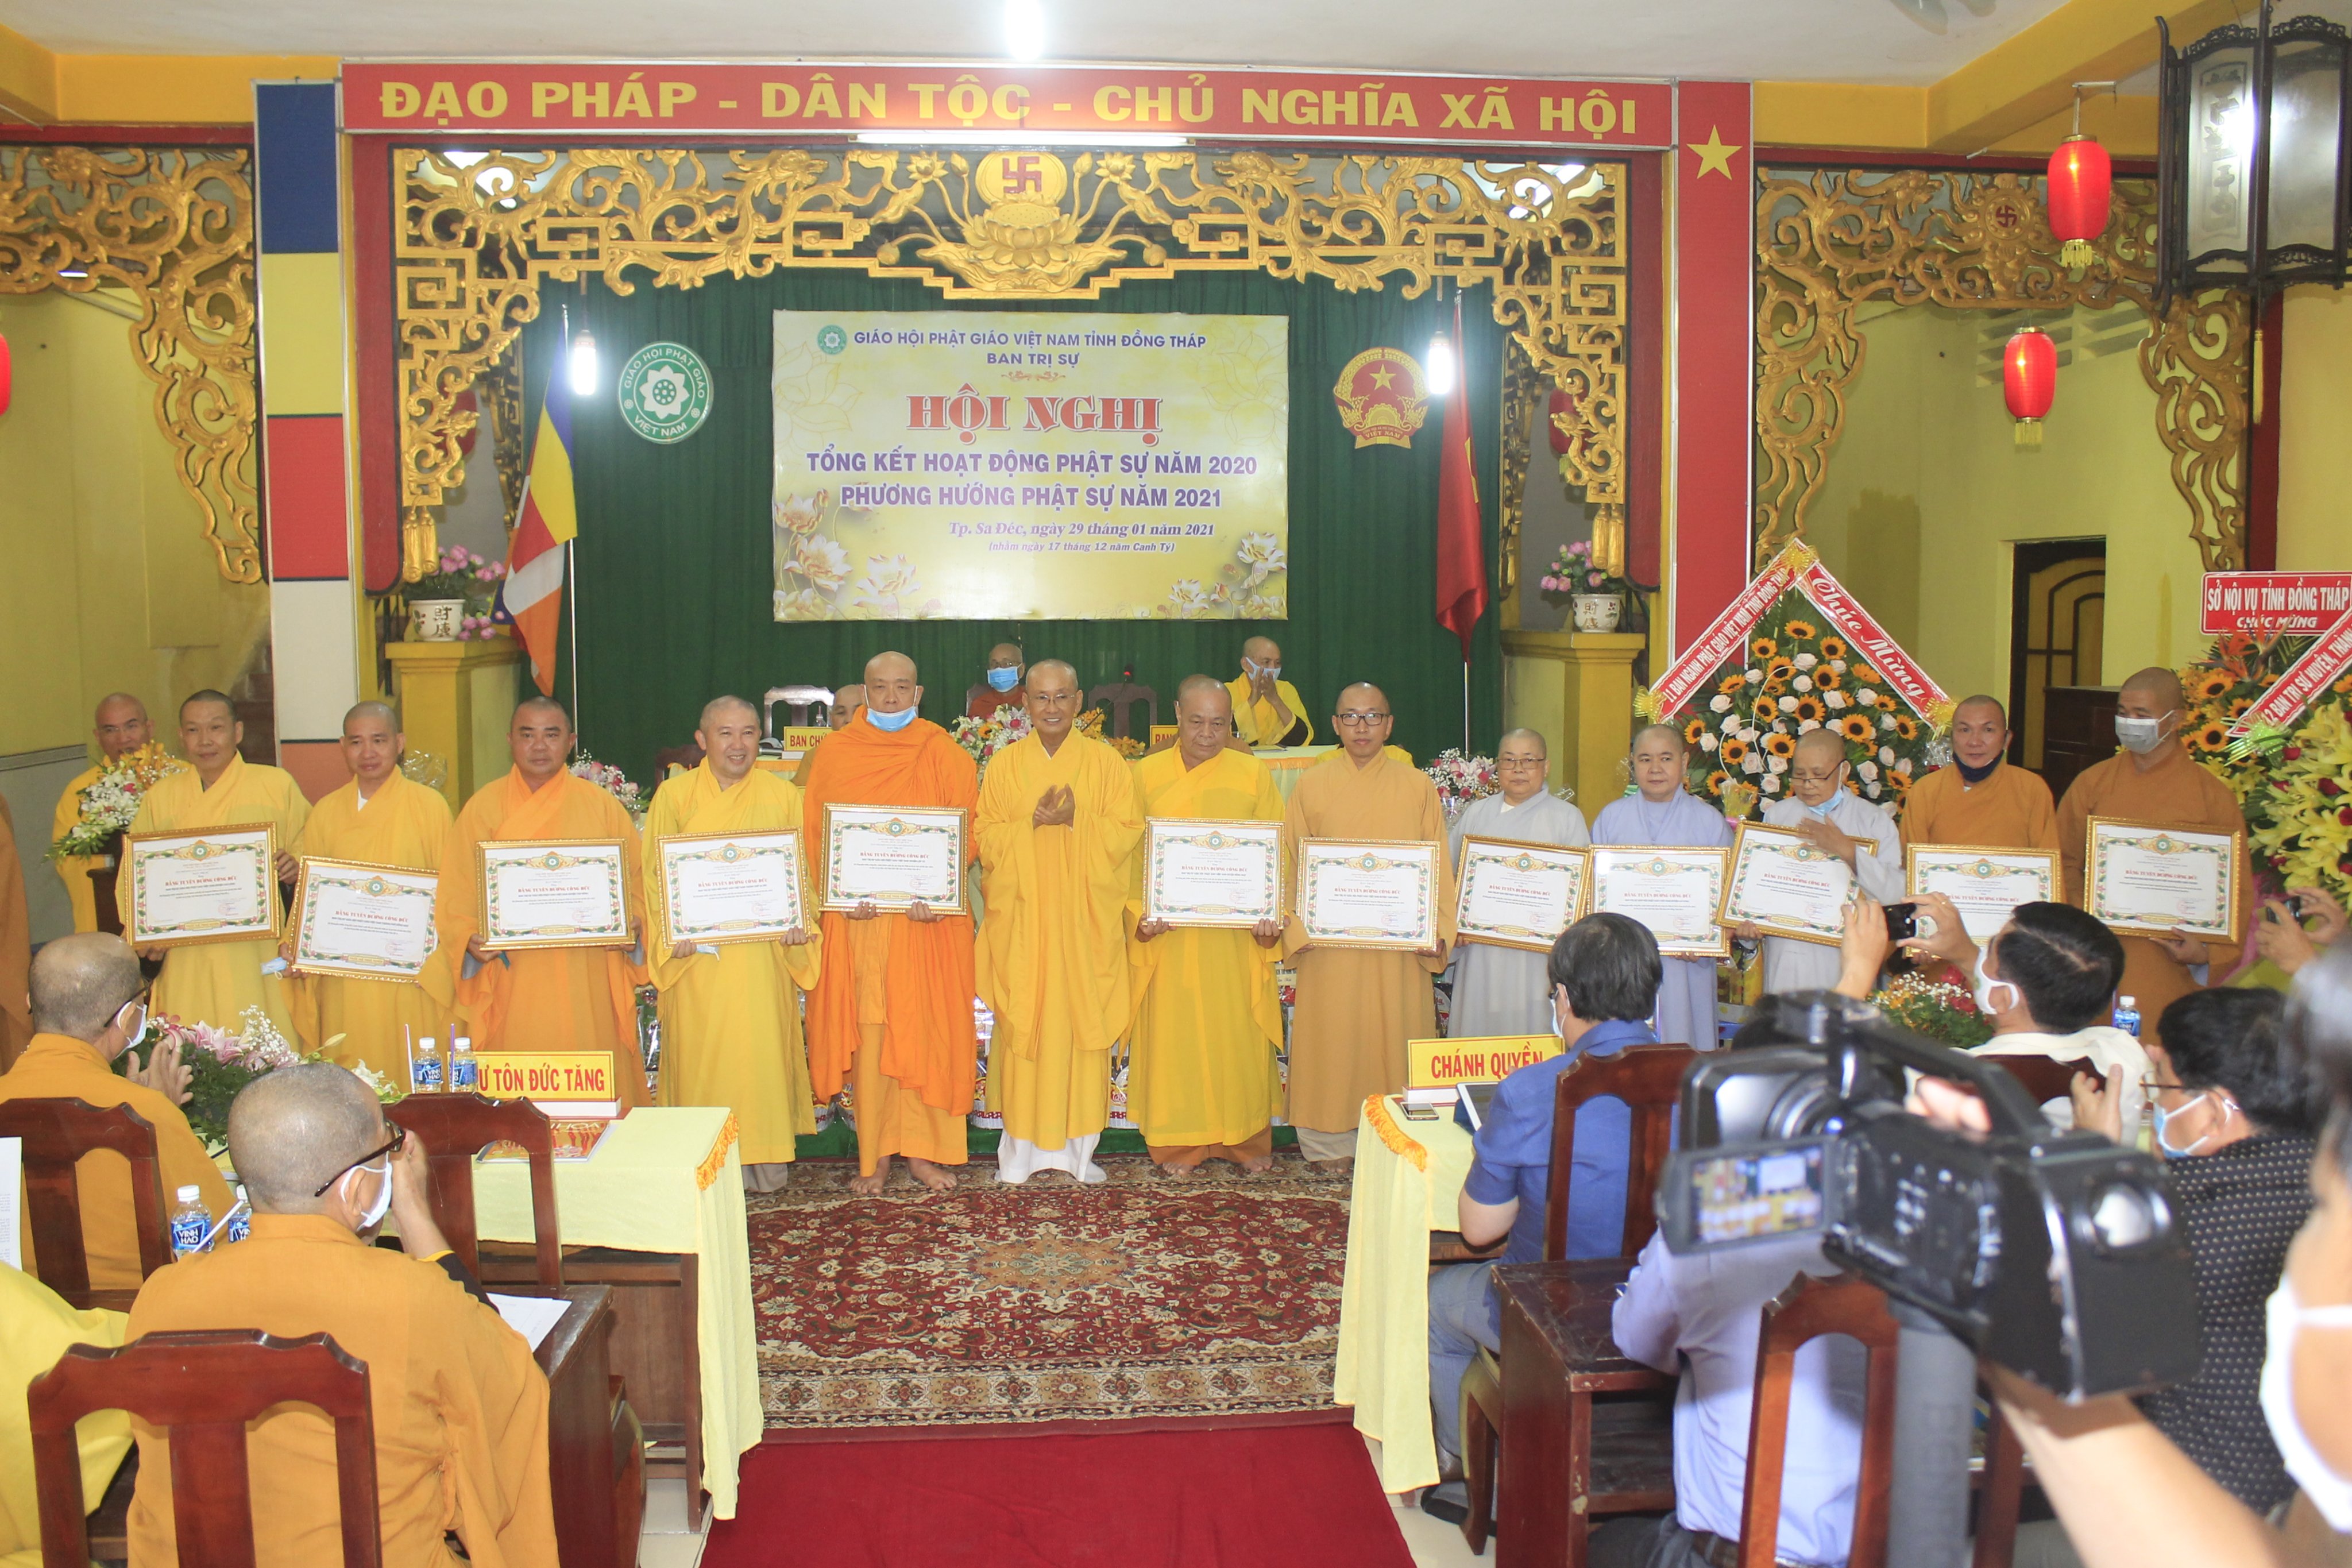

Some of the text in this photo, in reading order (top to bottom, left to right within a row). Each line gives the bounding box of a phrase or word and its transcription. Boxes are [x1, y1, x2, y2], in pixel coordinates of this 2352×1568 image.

[379, 72, 1636, 140] ĐẠO PHÁP - DÂN TỘC - CHỦ NGHĨA XÃ HỘI
[853, 329, 893, 345] GIÁO
[898, 329, 924, 347] HỘI
[929, 329, 965, 348] PHẬT
[970, 330, 1009, 345] GIÁO
[1014, 330, 1042, 349] VIỆT
[1046, 334, 1080, 347] NAM
[1084, 330, 1116, 347] TỈNH
[1121, 329, 1165, 347] ĐỒNG
[1171, 333, 1206, 349] THÁP
[987, 352, 1080, 368] BAN TRỊ SỰ
[906, 382, 1163, 447] HỘI NGHỊ
[661, 422, 687, 437] NAM
[806, 443, 1257, 478] TỔNG KẾT HOẠT ĐỘNG PHẬT SỰ NĂM 2020
[841, 481, 1221, 511] PHƯƠNG HƯỚNG PHẬT SỰ NĂM 2021
[949, 522, 1214, 538] Tp. Sa Đéc, ngày 29 tháng 01 năm 2021
[1022, 542, 1045, 552] ngày
[1048, 542, 1060, 551] 17
[1064, 542, 1091, 552] tháng
[1095, 543, 1106, 551] 12
[1110, 543, 1130, 551] năm
[1133, 543, 1156, 551] Canh
[2208, 577, 2350, 616] SỞ NỘI VỤ TỈNH ĐỒNG THÁP
[1733, 605, 1752, 627] NAM
[1722, 620, 1741, 639] VIỆT
[1812, 578, 1925, 699] Chúc Mừng
[1710, 632, 1729, 652] GIÁO
[1696, 644, 1718, 666] PHẬT
[1663, 688, 1677, 702] 11
[1669, 676, 1688, 696] BAN
[2269, 694, 2293, 717] BAN
[790, 735, 806, 747] BAN
[1431, 1048, 1485, 1079] CHÁNH
[493, 1063, 523, 1091] TÔN
[529, 1063, 559, 1091] ĐỨC
[565, 1064, 605, 1091] TĂNG
[179, 1228, 199, 1238] VINH
